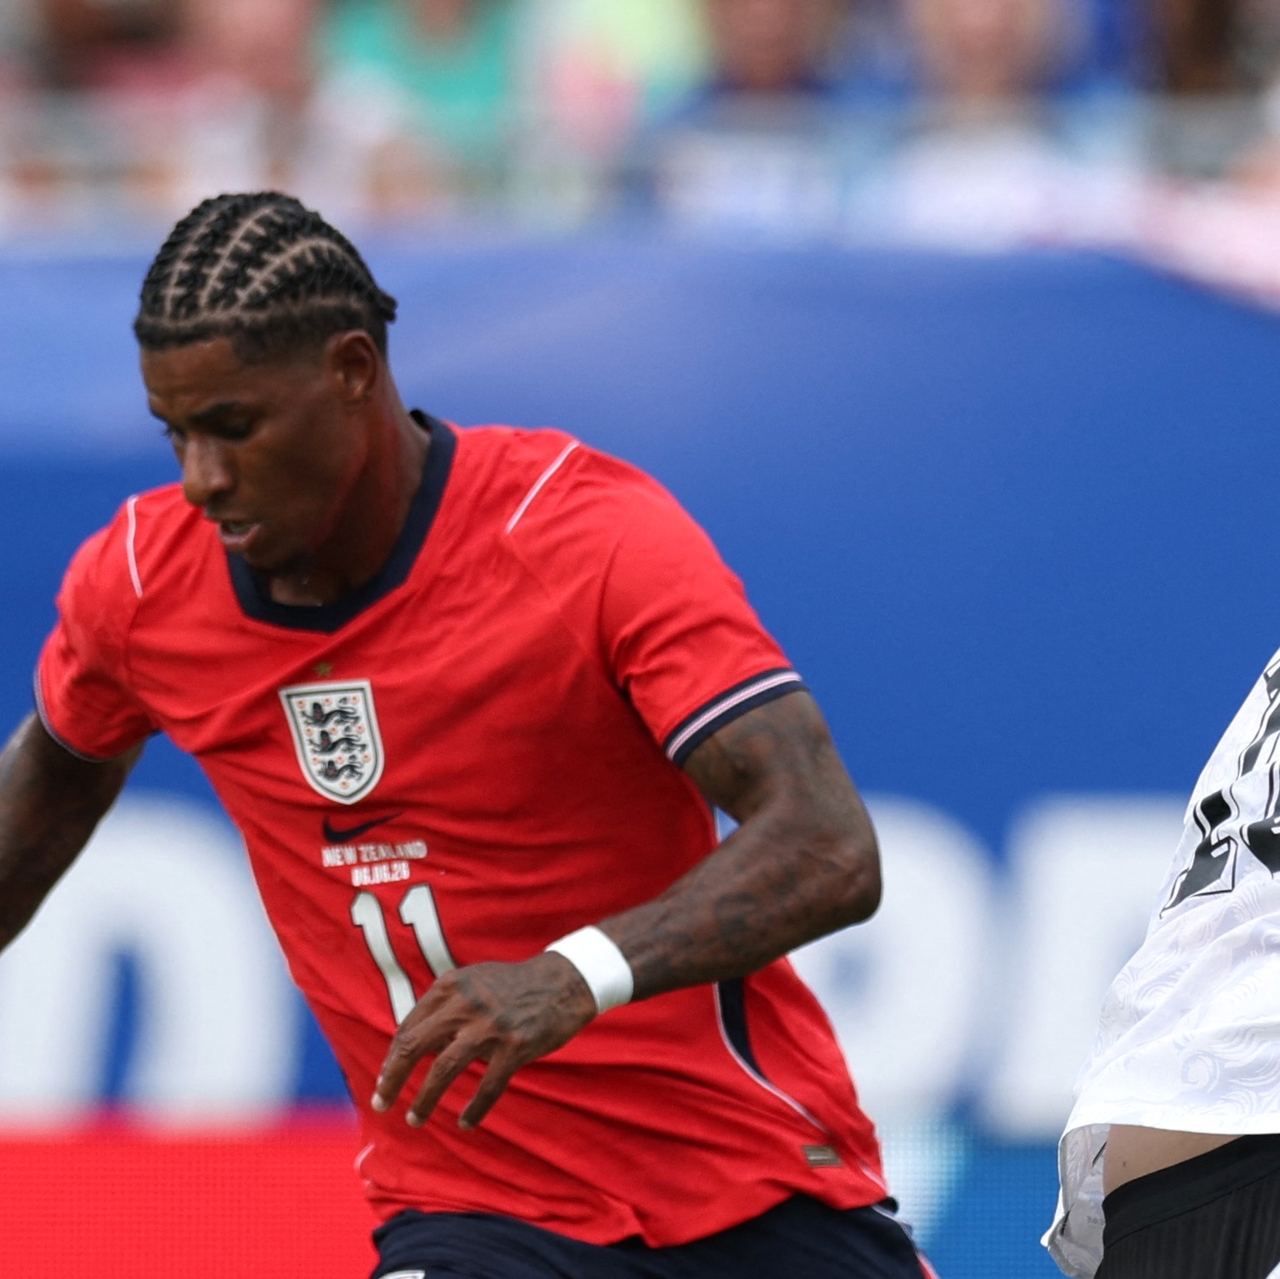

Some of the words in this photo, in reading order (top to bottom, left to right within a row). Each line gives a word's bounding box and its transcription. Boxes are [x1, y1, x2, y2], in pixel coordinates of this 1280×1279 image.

[322, 846, 357, 867] NEW
[358, 840, 427, 861] ZEALAND
[350, 883, 458, 1026] 11
